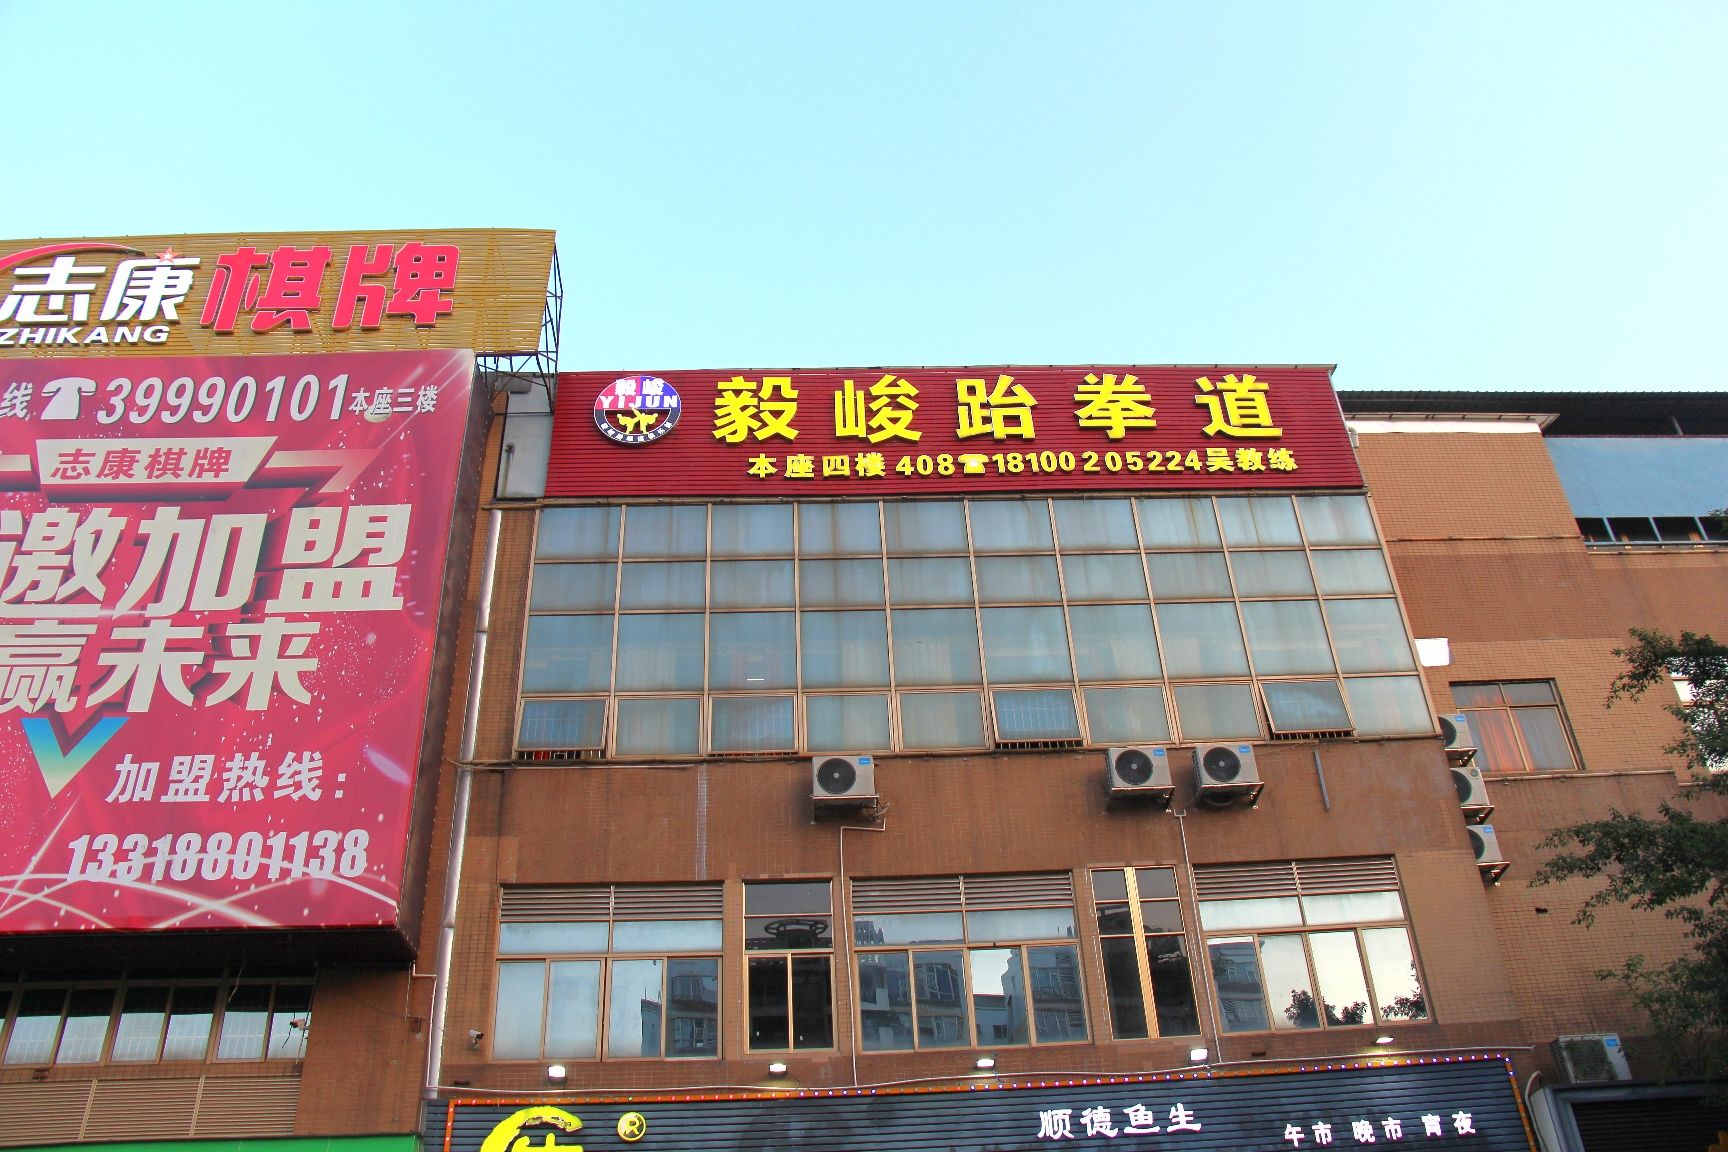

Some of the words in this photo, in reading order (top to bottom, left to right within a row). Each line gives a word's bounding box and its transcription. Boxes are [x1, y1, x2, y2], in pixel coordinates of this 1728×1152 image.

[0, 256, 200, 324] 志康
[201, 243, 460, 335] 棋牌
[0, 326, 169, 345] ZHIKANG
[97, 374, 348, 424] 39990101
[348, 384, 438, 416] 本座三楼
[600, 395, 678, 408] YIJUN
[712, 373, 1283, 443] 毅峻跆拳道
[50, 446, 233, 480] 志康棋牌
[895, 453, 955, 476] 408
[0, 617, 320, 714] 赢未来
[67, 829, 370, 882] 13318801138
[1037, 1103, 1201, 1139] 顺德鱼生
